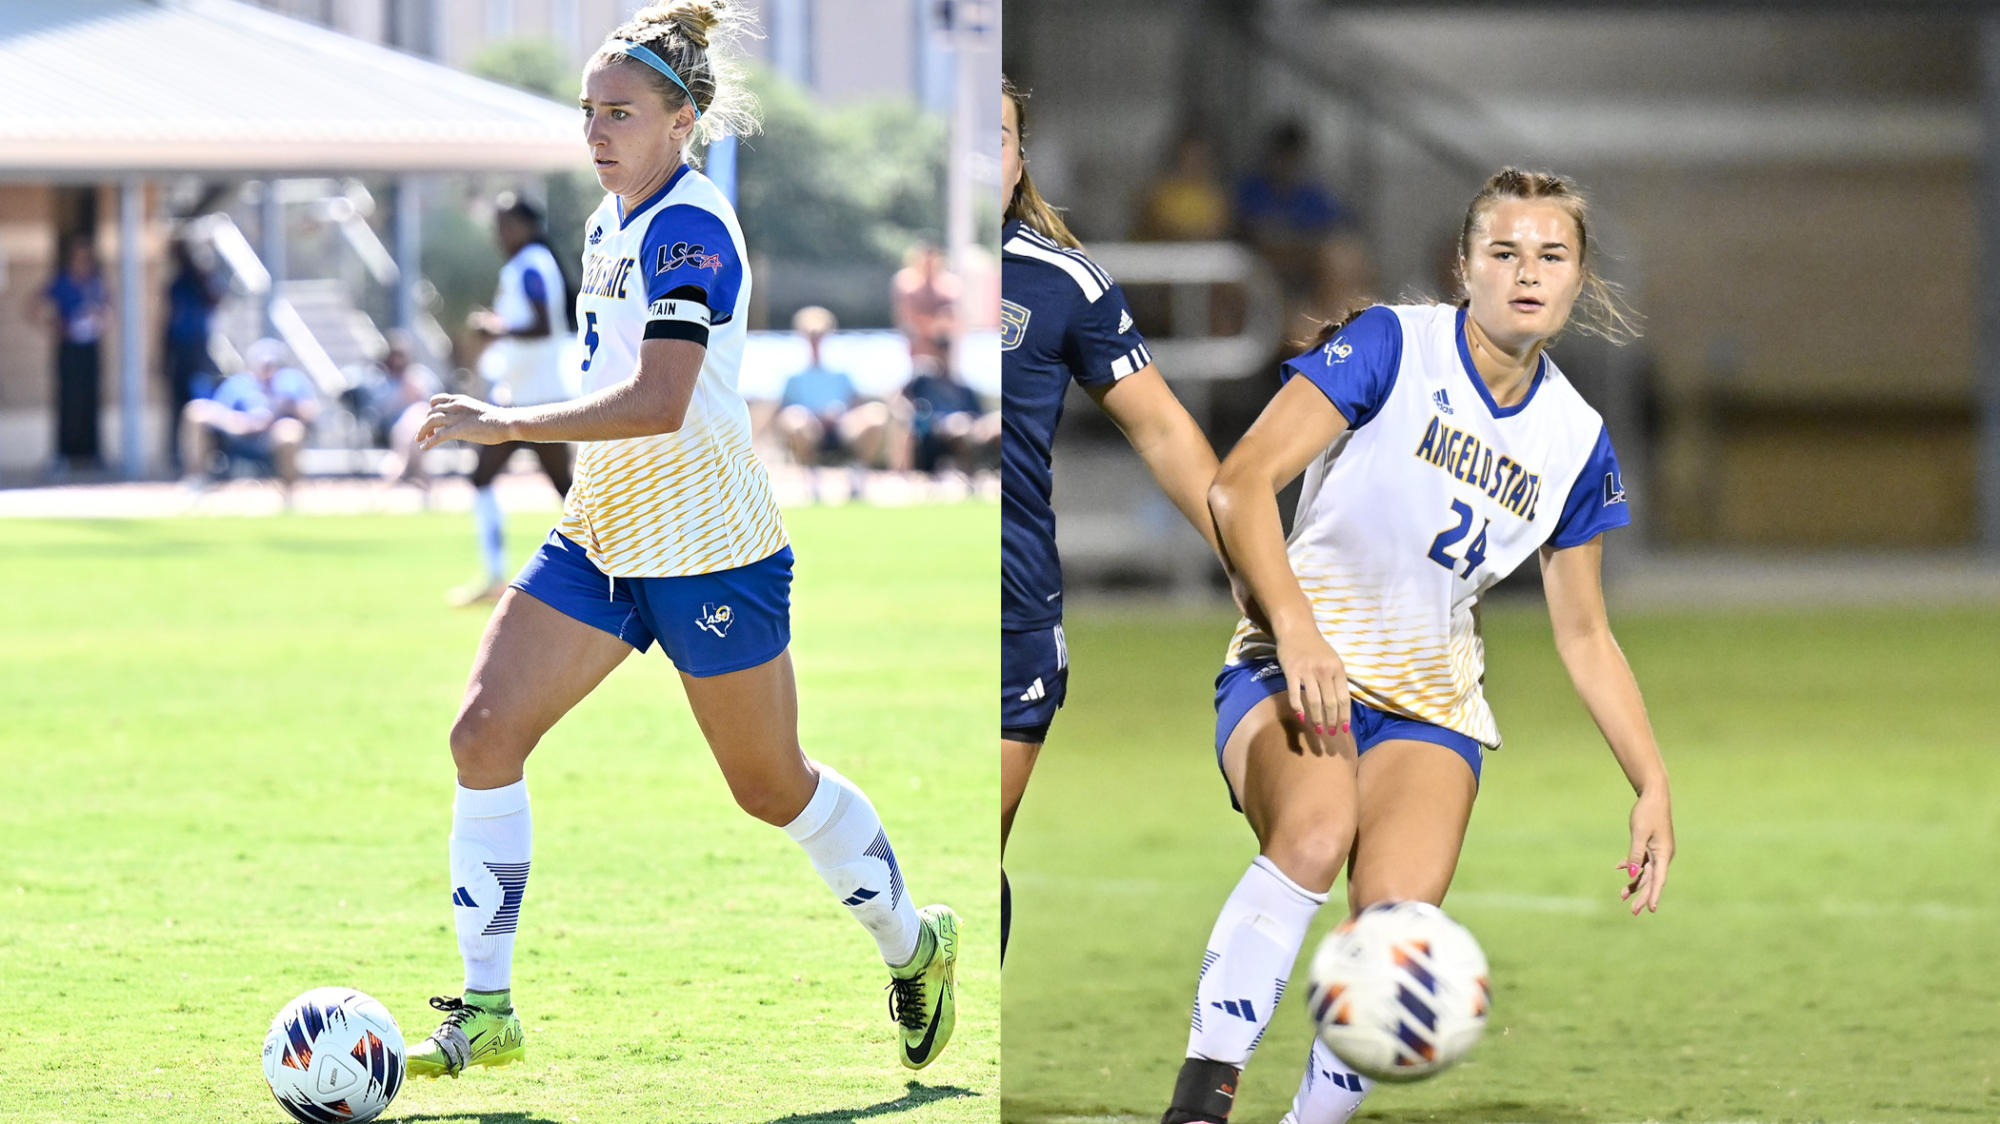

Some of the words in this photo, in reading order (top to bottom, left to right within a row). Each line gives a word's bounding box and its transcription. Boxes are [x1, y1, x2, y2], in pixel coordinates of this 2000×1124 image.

[656, 242, 705, 272] LSC
[649, 302, 677, 316] TAIN
[581, 310, 599, 373] 5
[1414, 414, 1493, 491] ANGELO
[1427, 496, 1491, 581] 24
[706, 605, 730, 624] ASU
